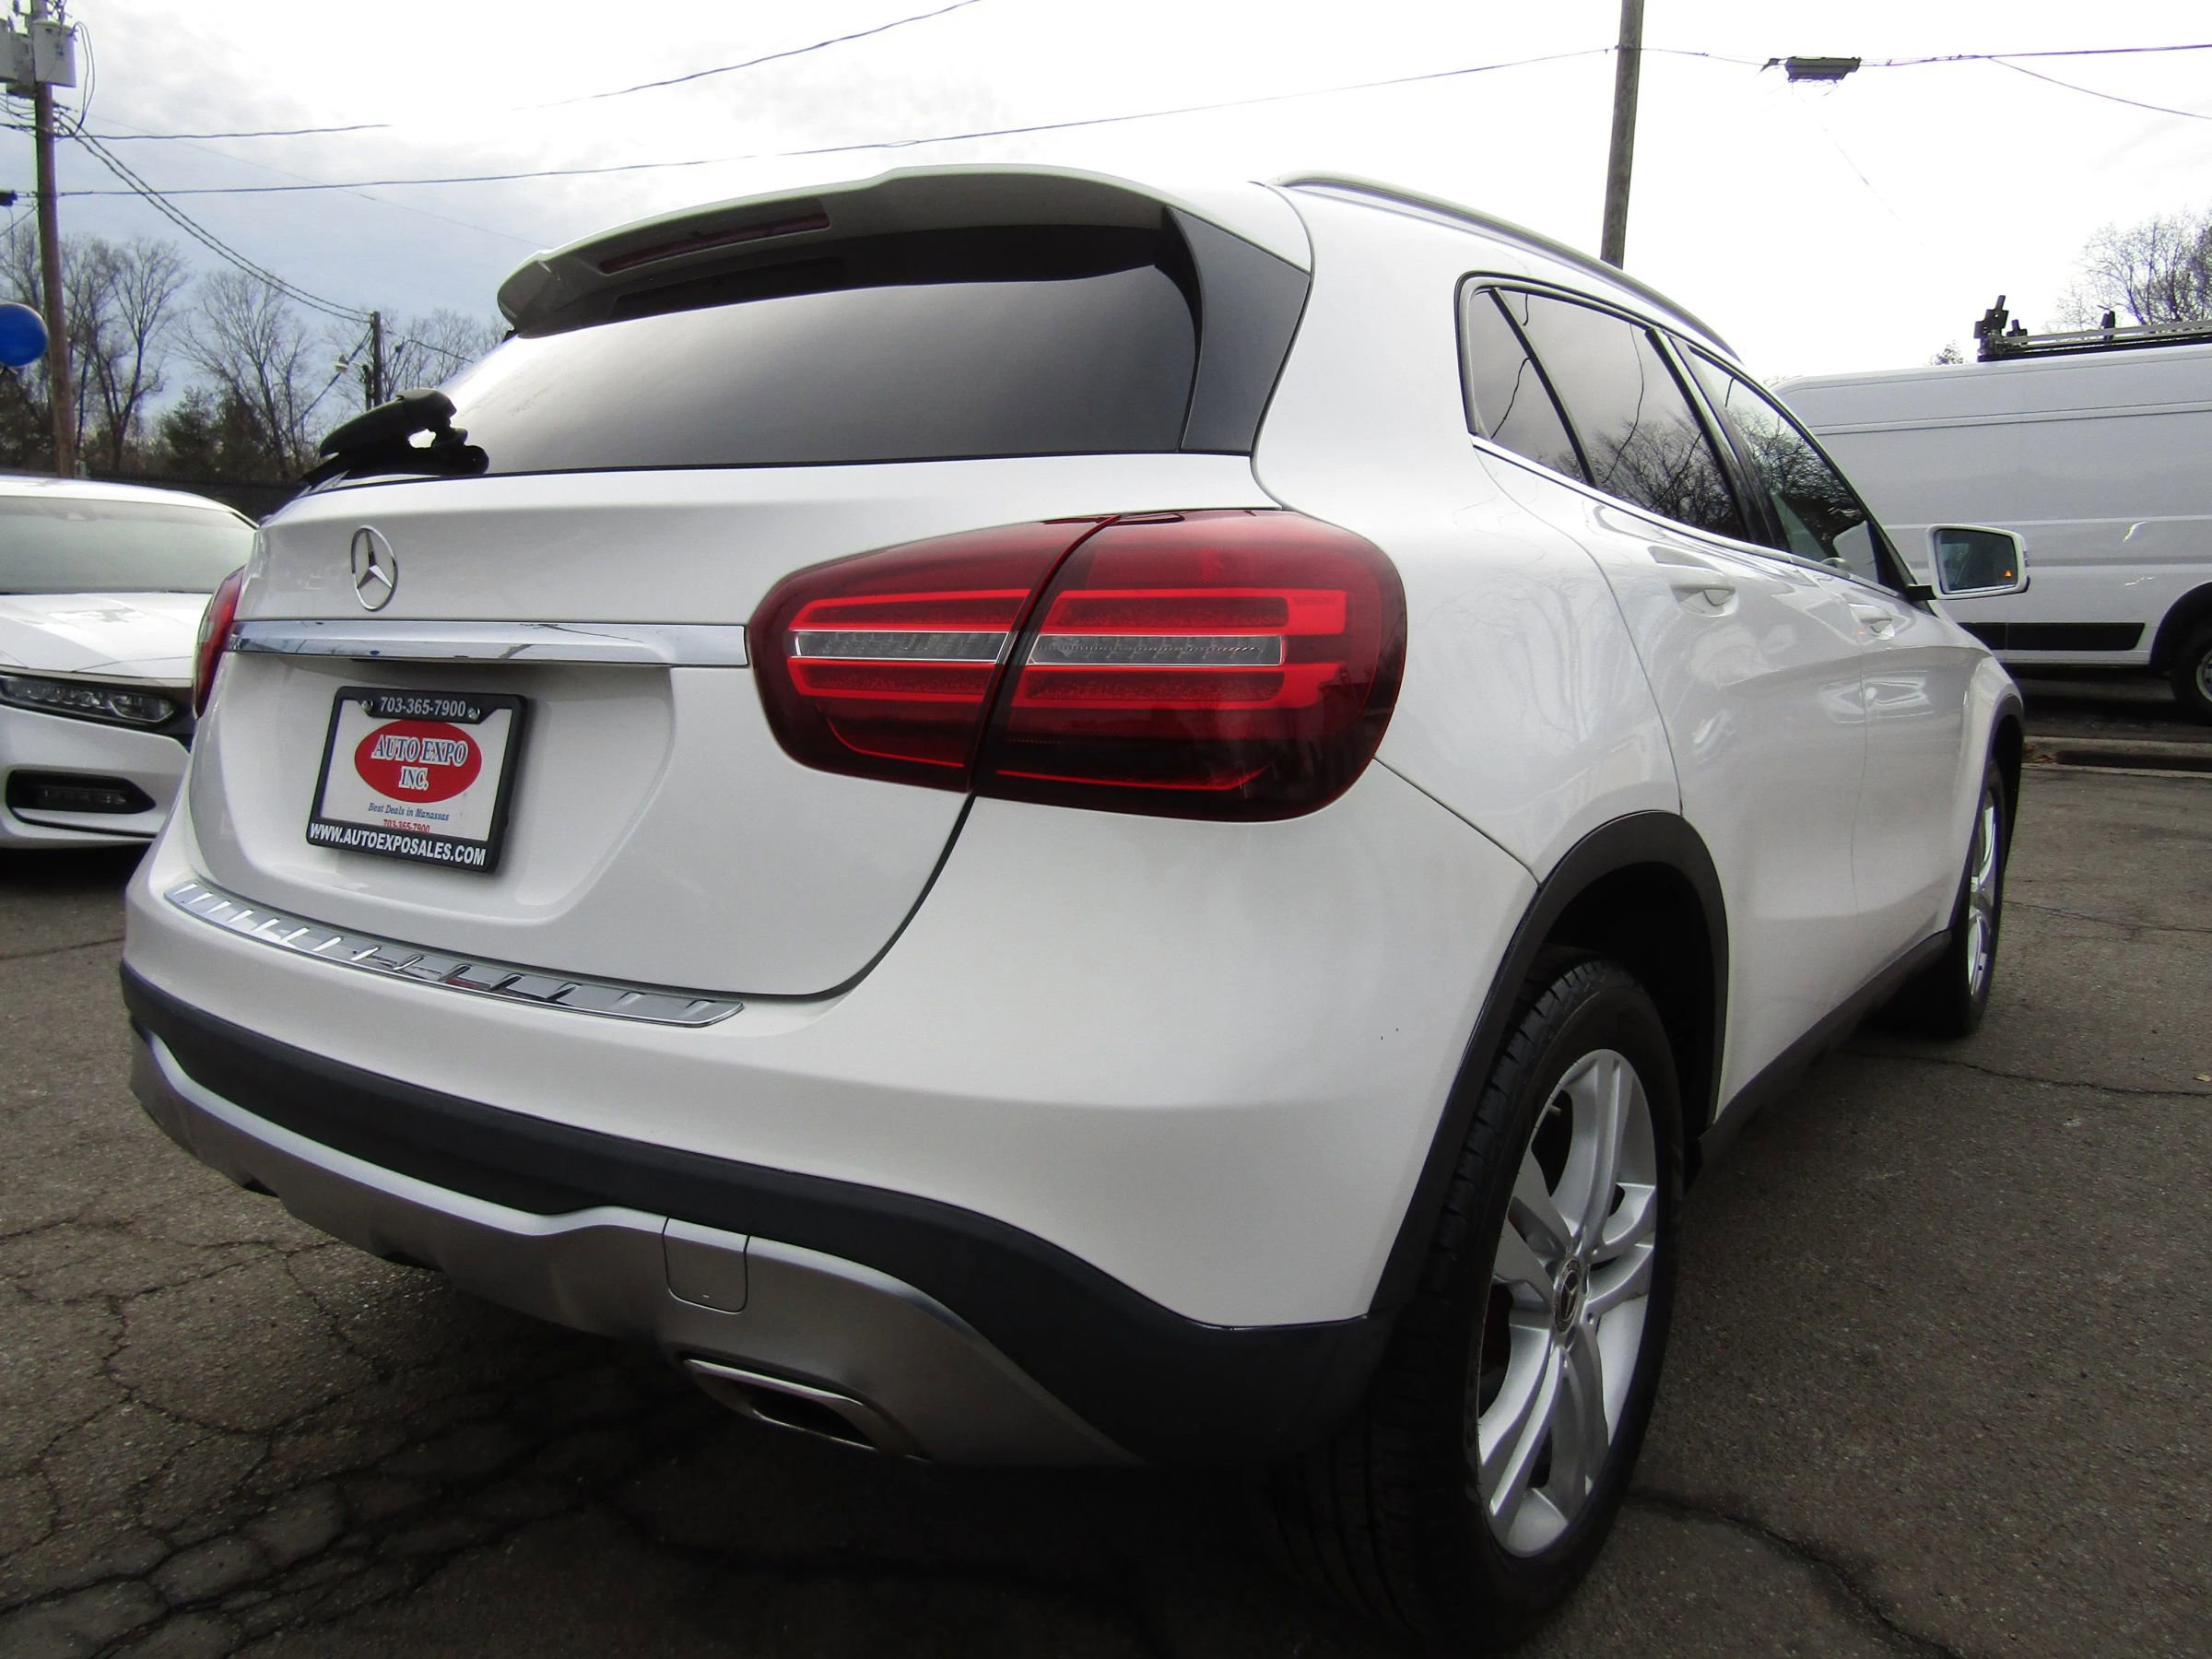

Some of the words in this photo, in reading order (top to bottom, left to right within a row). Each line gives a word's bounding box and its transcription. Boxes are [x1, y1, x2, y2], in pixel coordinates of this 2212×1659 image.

[380, 697, 466, 717] 703-365-7900
[371, 735, 420, 762] AUTO
[419, 738, 468, 767] EXPO
[398, 766, 429, 791] INC.
[369, 803, 383, 812] Best
[385, 805, 405, 816] Deals
[406, 807, 414, 817] in
[415, 808, 450, 821] Manassas
[310, 822, 487, 866] WWW.AUTOEXPOSALES.COM
